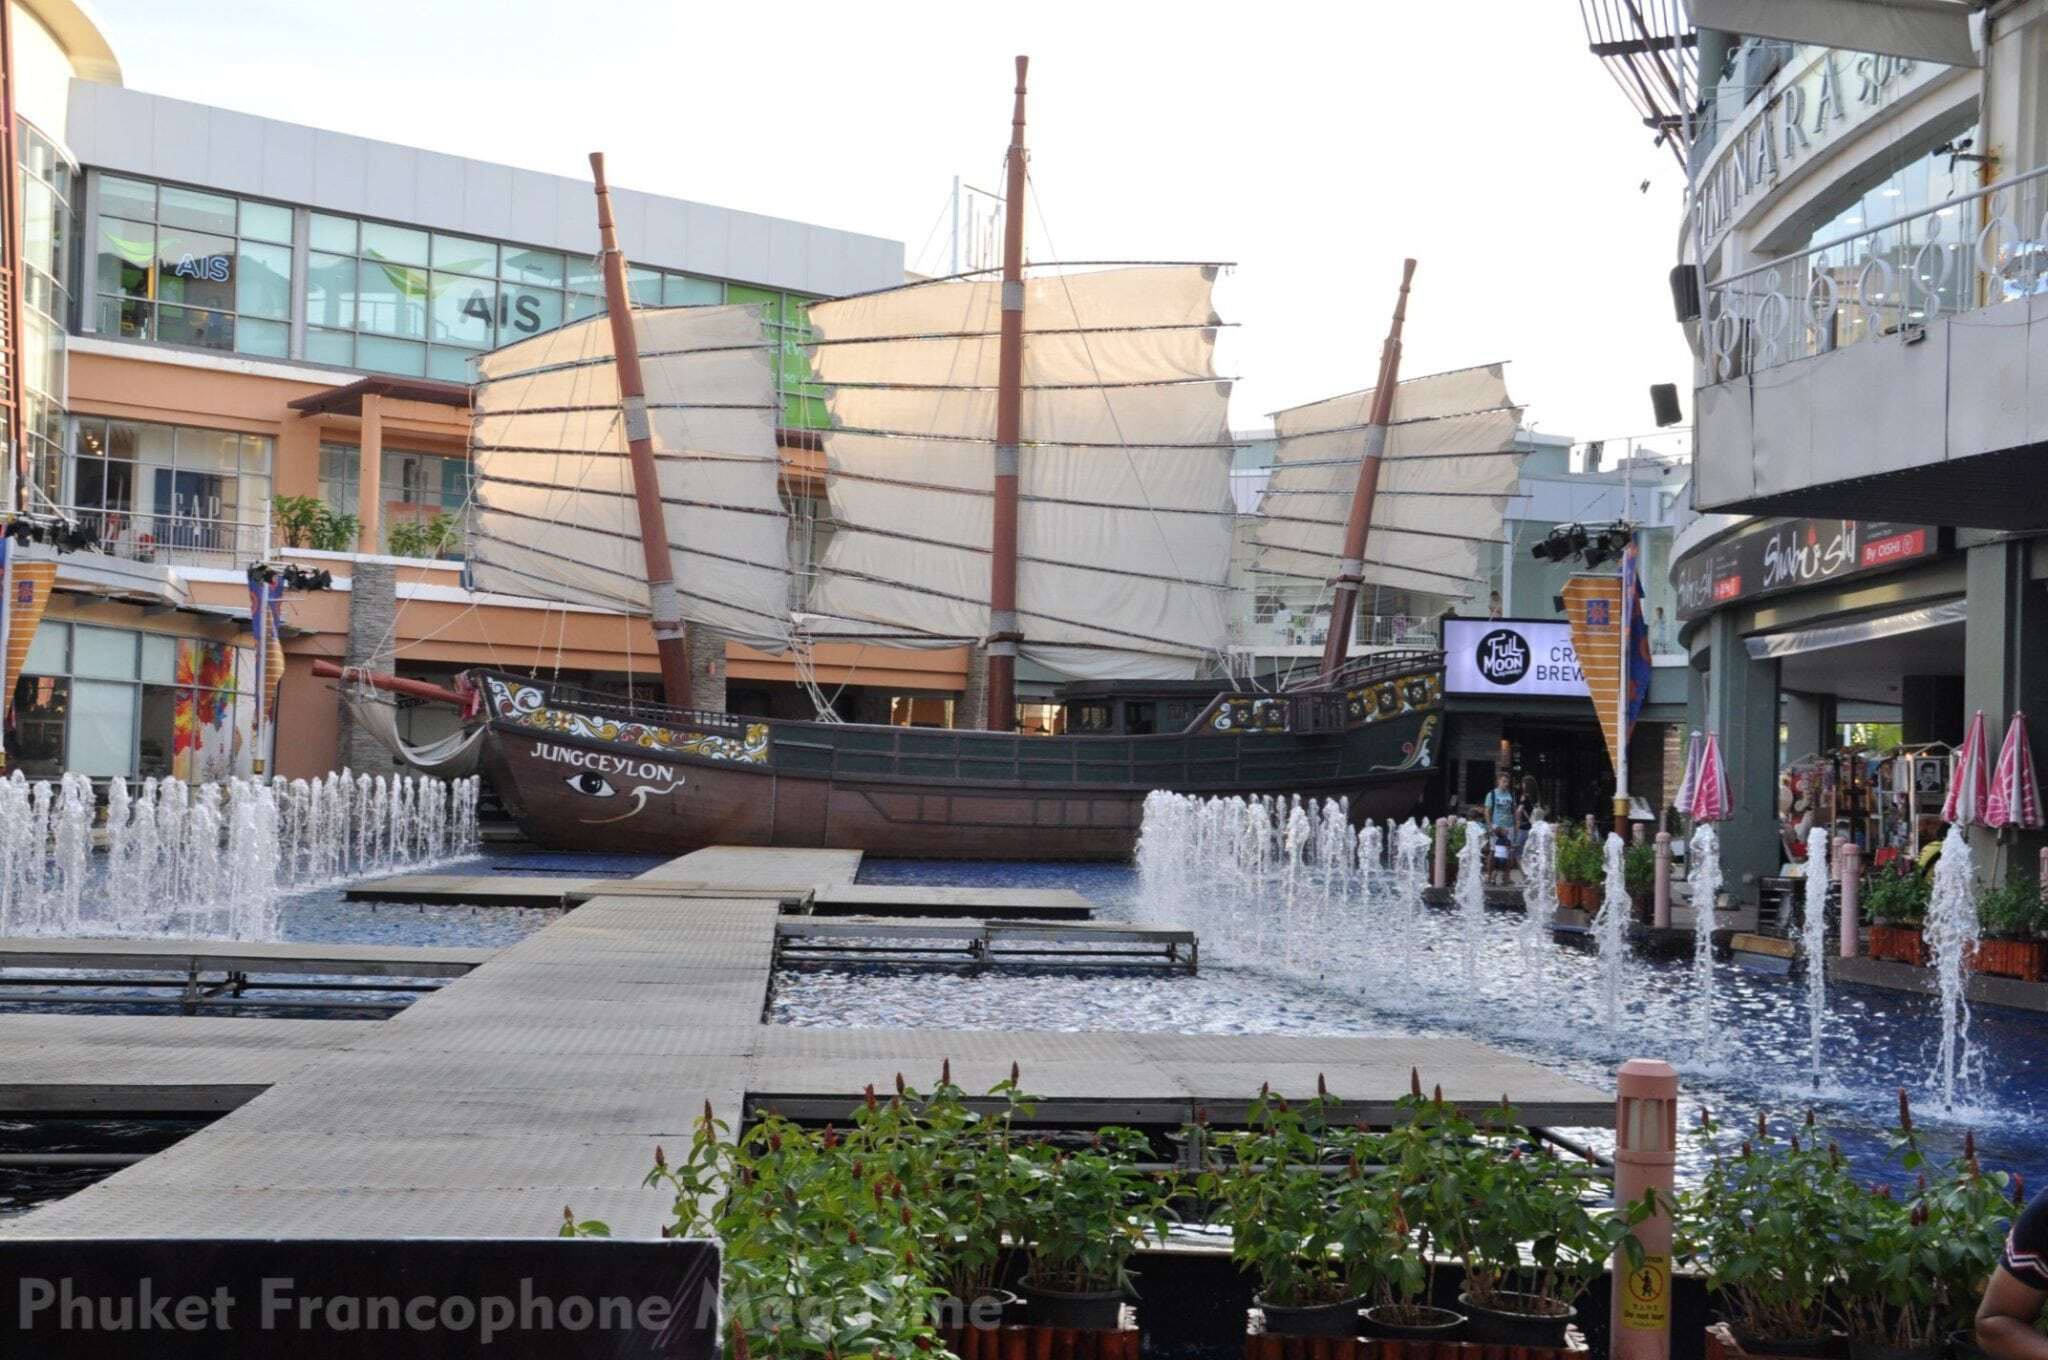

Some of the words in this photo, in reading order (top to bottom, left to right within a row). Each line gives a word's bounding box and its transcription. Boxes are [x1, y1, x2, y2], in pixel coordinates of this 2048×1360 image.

[175, 252, 230, 283] AIS
[457, 288, 542, 334] AIS
[170, 491, 221, 530] GAP
[1536, 664, 1585, 682] BREW
[530, 742, 674, 782] JUNGCEYLON
